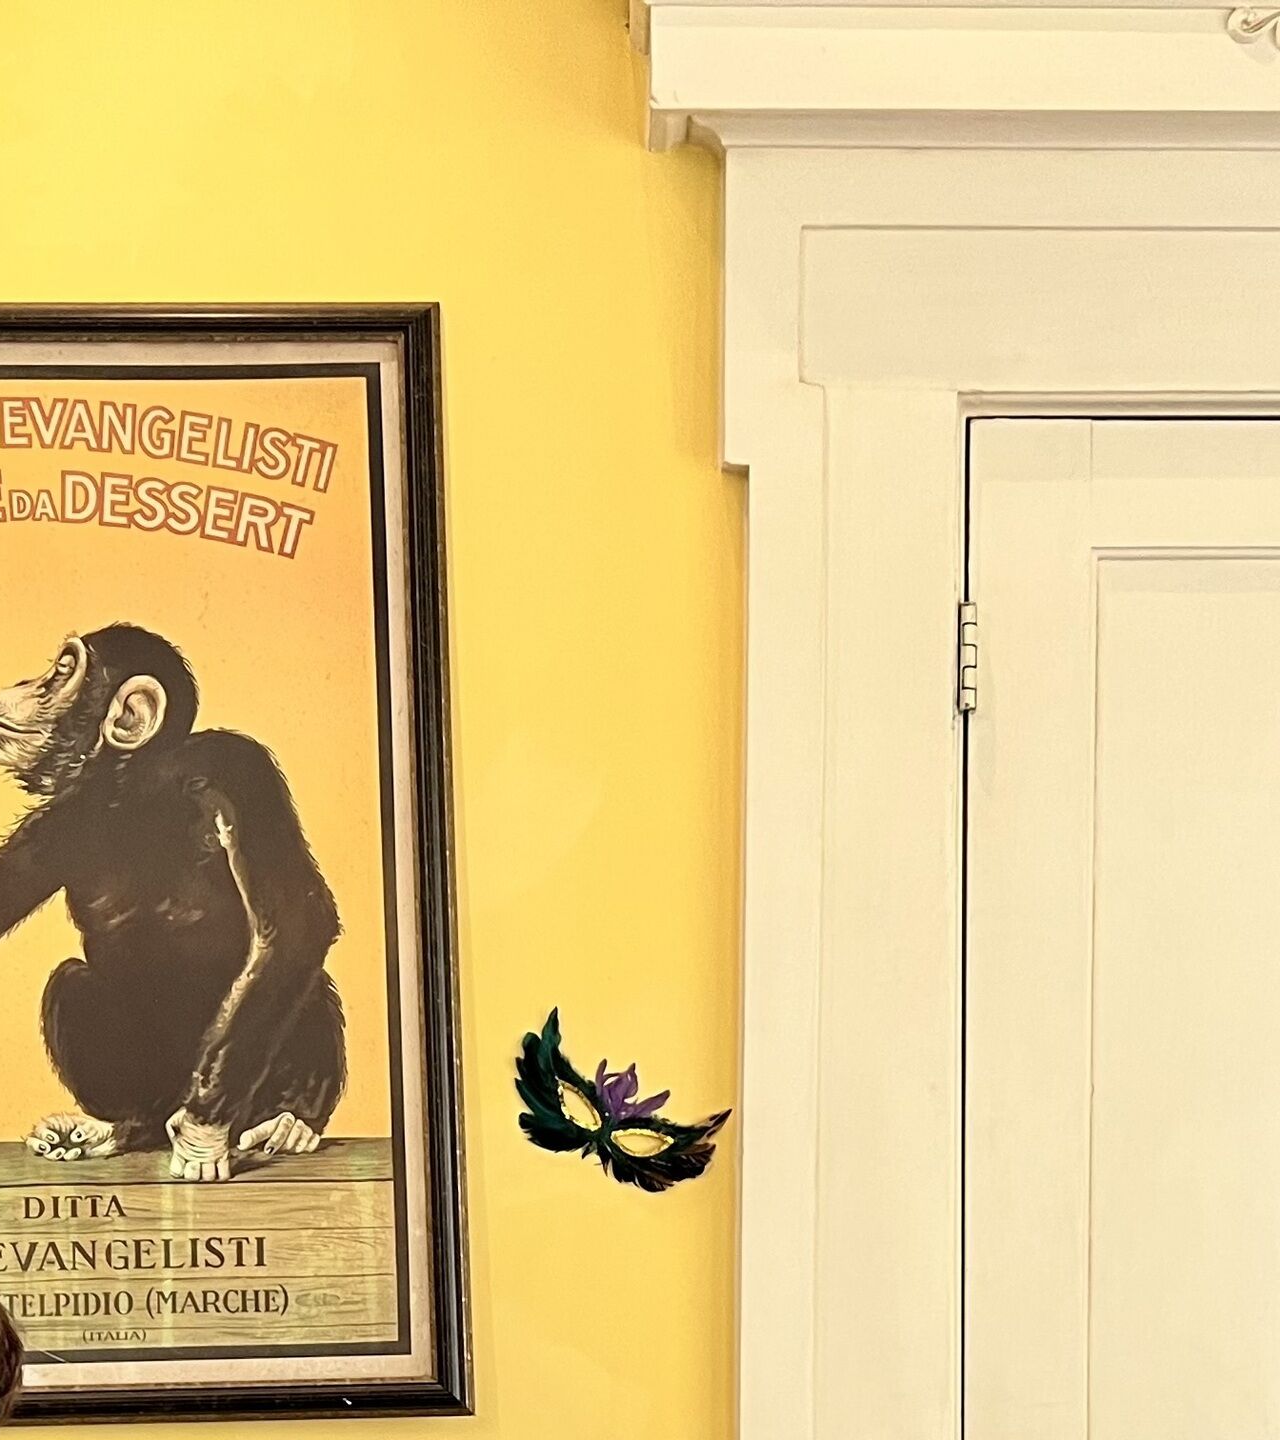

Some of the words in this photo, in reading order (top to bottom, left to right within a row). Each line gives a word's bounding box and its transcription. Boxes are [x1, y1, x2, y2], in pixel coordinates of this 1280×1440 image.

[8, 487, 60, 523] DA
[60, 471, 315, 560] DESSERT
[22, 1194, 128, 1220] DITTA
[144, 1283, 289, 1320] (MARCHE)
[82, 1328, 147, 1345] (ITALIA)
